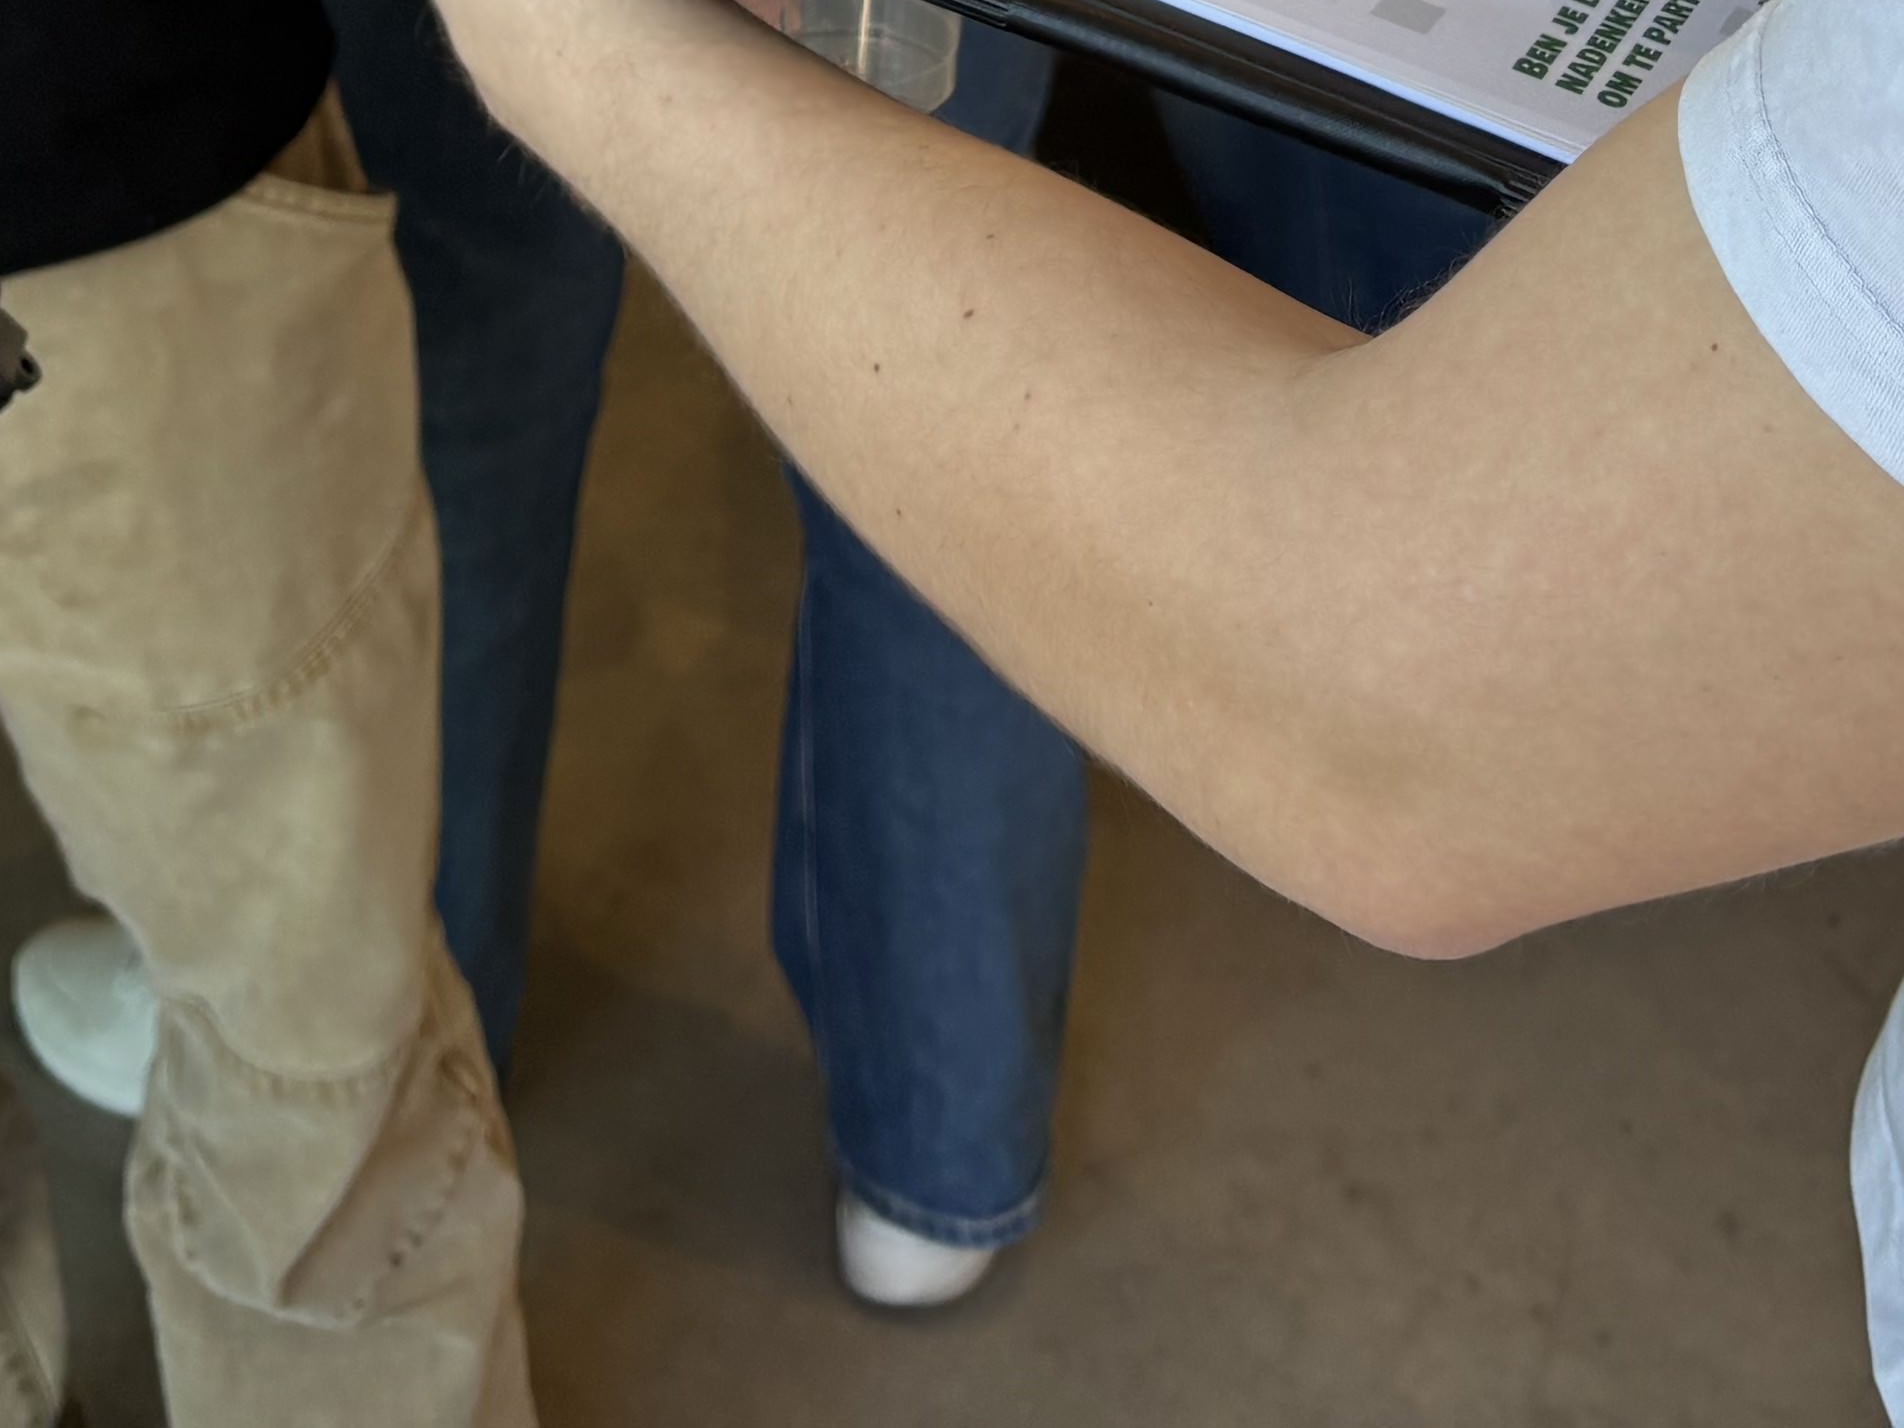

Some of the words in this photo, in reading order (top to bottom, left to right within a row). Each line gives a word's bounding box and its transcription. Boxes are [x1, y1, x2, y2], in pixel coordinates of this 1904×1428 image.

[1512, 33, 1568, 80] BEN
[1551, 5, 1589, 35] JE
[1596, 70, 1643, 109] OM
[1622, 43, 1664, 73] TE
